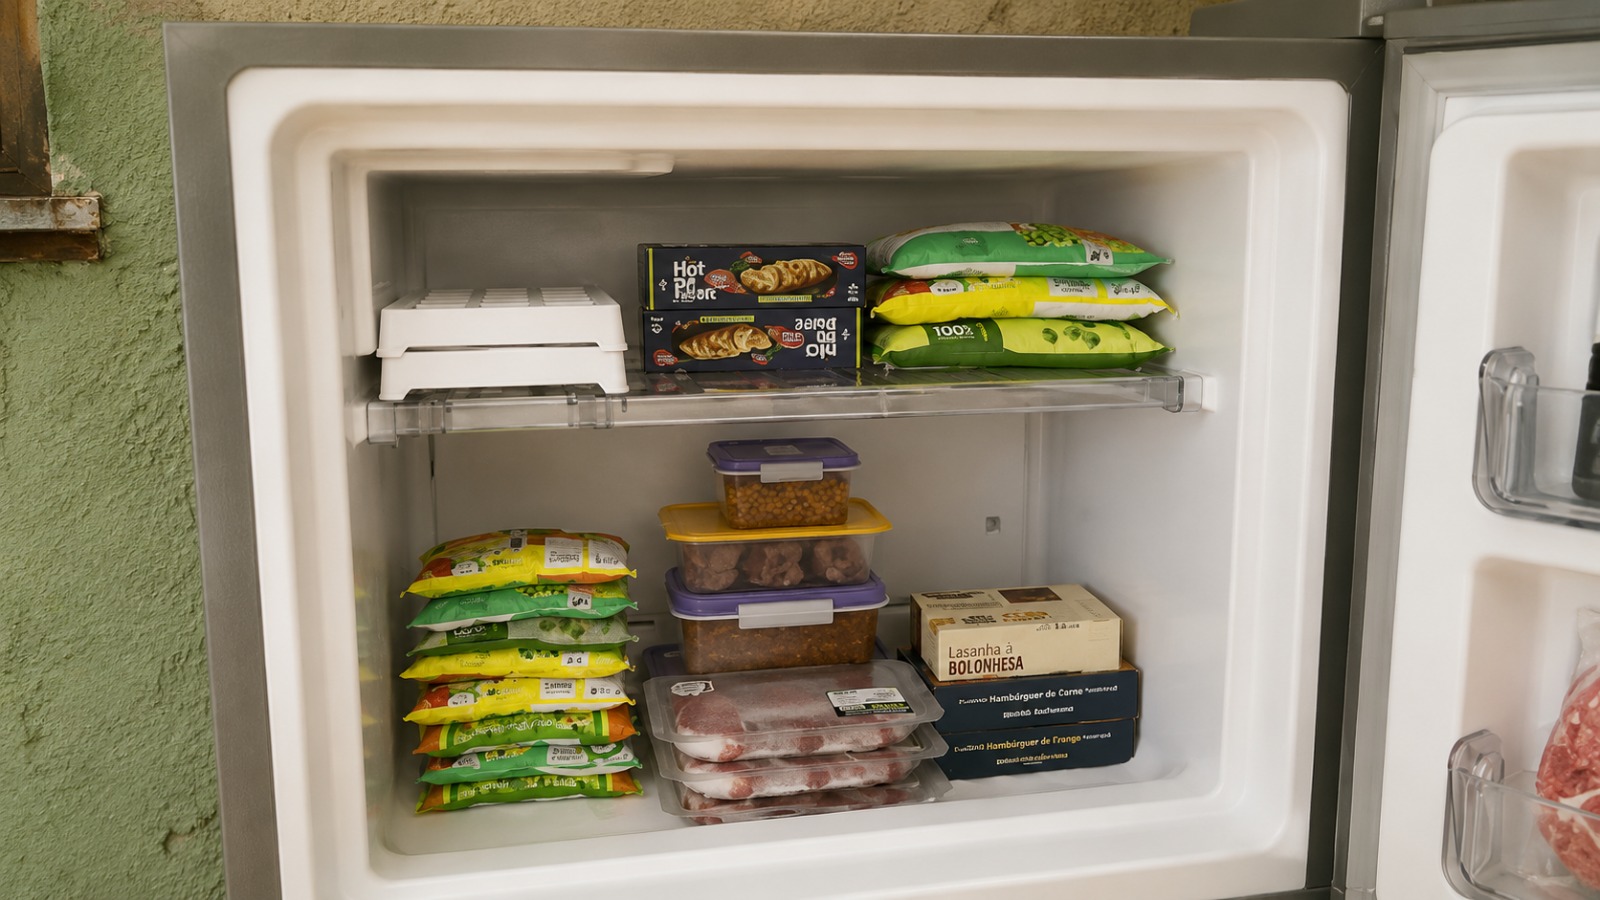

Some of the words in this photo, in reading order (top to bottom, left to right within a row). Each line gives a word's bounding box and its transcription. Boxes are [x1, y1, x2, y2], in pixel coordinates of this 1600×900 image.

[673, 260, 706, 277] Hot
[932, 325, 974, 337] 100%
[949, 643, 1001, 659] Lasanha
[949, 655, 1024, 676] BOLONHESA
[989, 692, 1044, 703] Hambúrguer
[1045, 689, 1057, 698] de
[1058, 688, 1084, 697] Carne
[986, 739, 1039, 750] Hambúrguer
[1040, 736, 1051, 745] de
